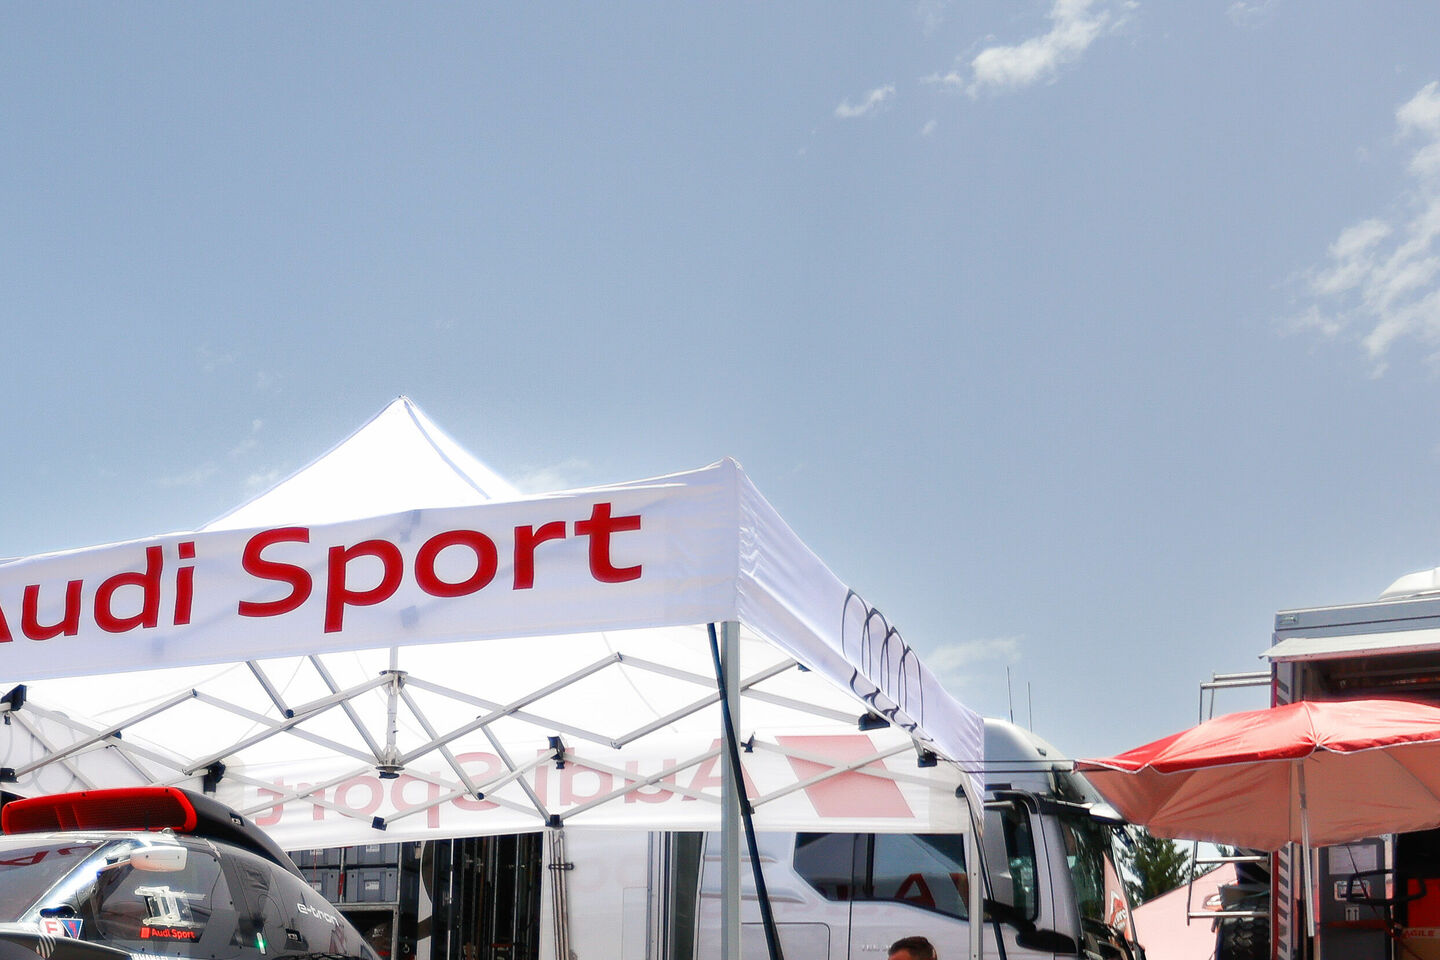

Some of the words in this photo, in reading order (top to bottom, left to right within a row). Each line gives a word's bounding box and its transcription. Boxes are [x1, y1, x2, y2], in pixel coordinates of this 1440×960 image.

[238, 502, 642, 633] Sport
[297, 903, 340, 928] e-tron
[152, 929, 169, 938] Audi
[171, 929, 196, 940] Sport
